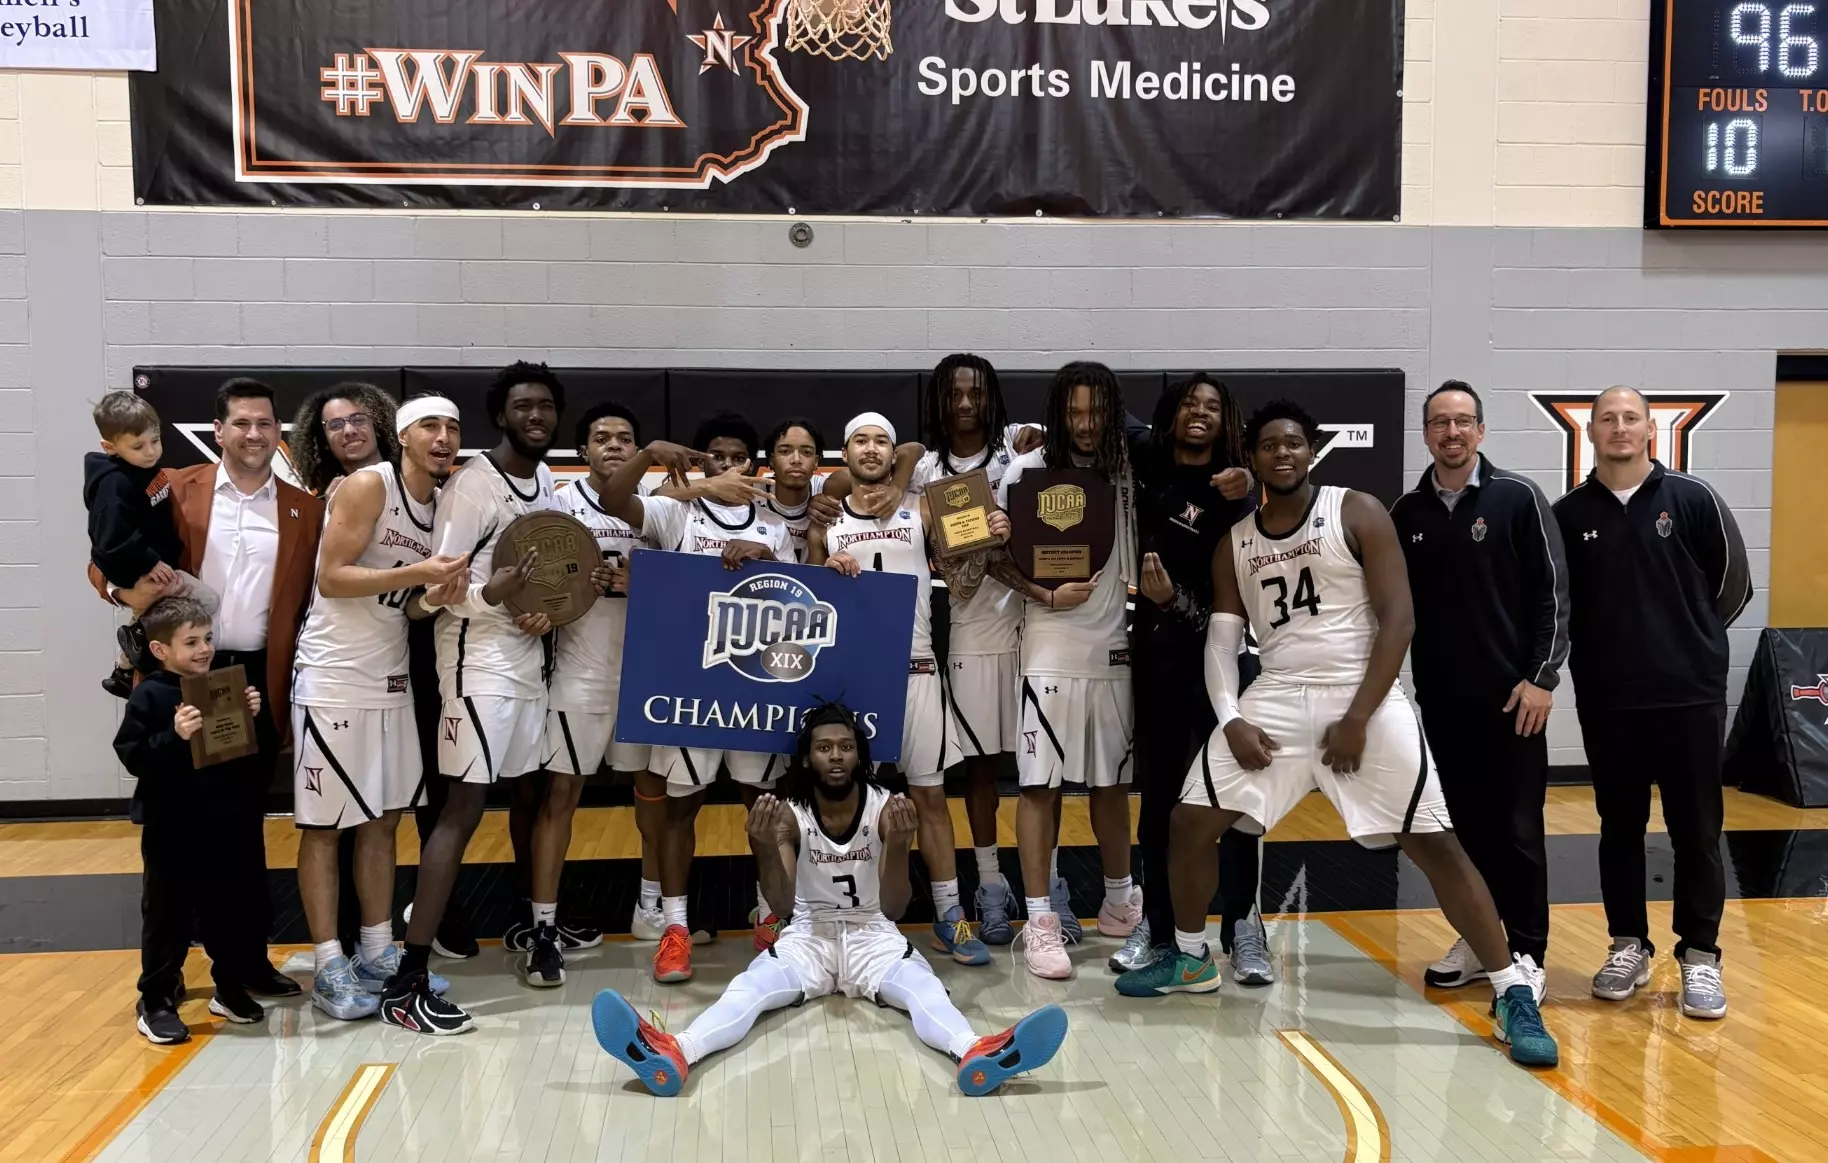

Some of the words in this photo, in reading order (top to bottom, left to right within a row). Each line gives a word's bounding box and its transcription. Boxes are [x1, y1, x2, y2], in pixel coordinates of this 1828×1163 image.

[0, 15, 89, 46] eyball
[1731, 2, 1818, 78] 96
[917, 56, 1071, 104] Sports
[1090, 60, 1295, 102] Medicine
[1698, 88, 1768, 112] FOULS
[1706, 118, 1758, 175] 10
[1693, 190, 1764, 214] SCORE
[1347, 430, 1368, 441] TM
[290, 508, 299, 518] N
[1040, 493, 1084, 514] NJCAA
[1180, 502, 1204, 527] N
[836, 528, 913, 551] NORTHAMPTON
[566, 563, 578, 574] 19
[1248, 537, 1324, 576] NORTHAMPTON
[749, 579, 789, 592] REGION
[790, 586, 803, 598] 19
[1261, 566, 1321, 630] 34
[713, 600, 830, 656] NJCAA
[769, 652, 803, 670] XIX
[445, 717, 462, 747] N
[643, 695, 879, 740] CHAMPIS
[304, 766, 324, 797] N
[832, 874, 860, 909] 3
